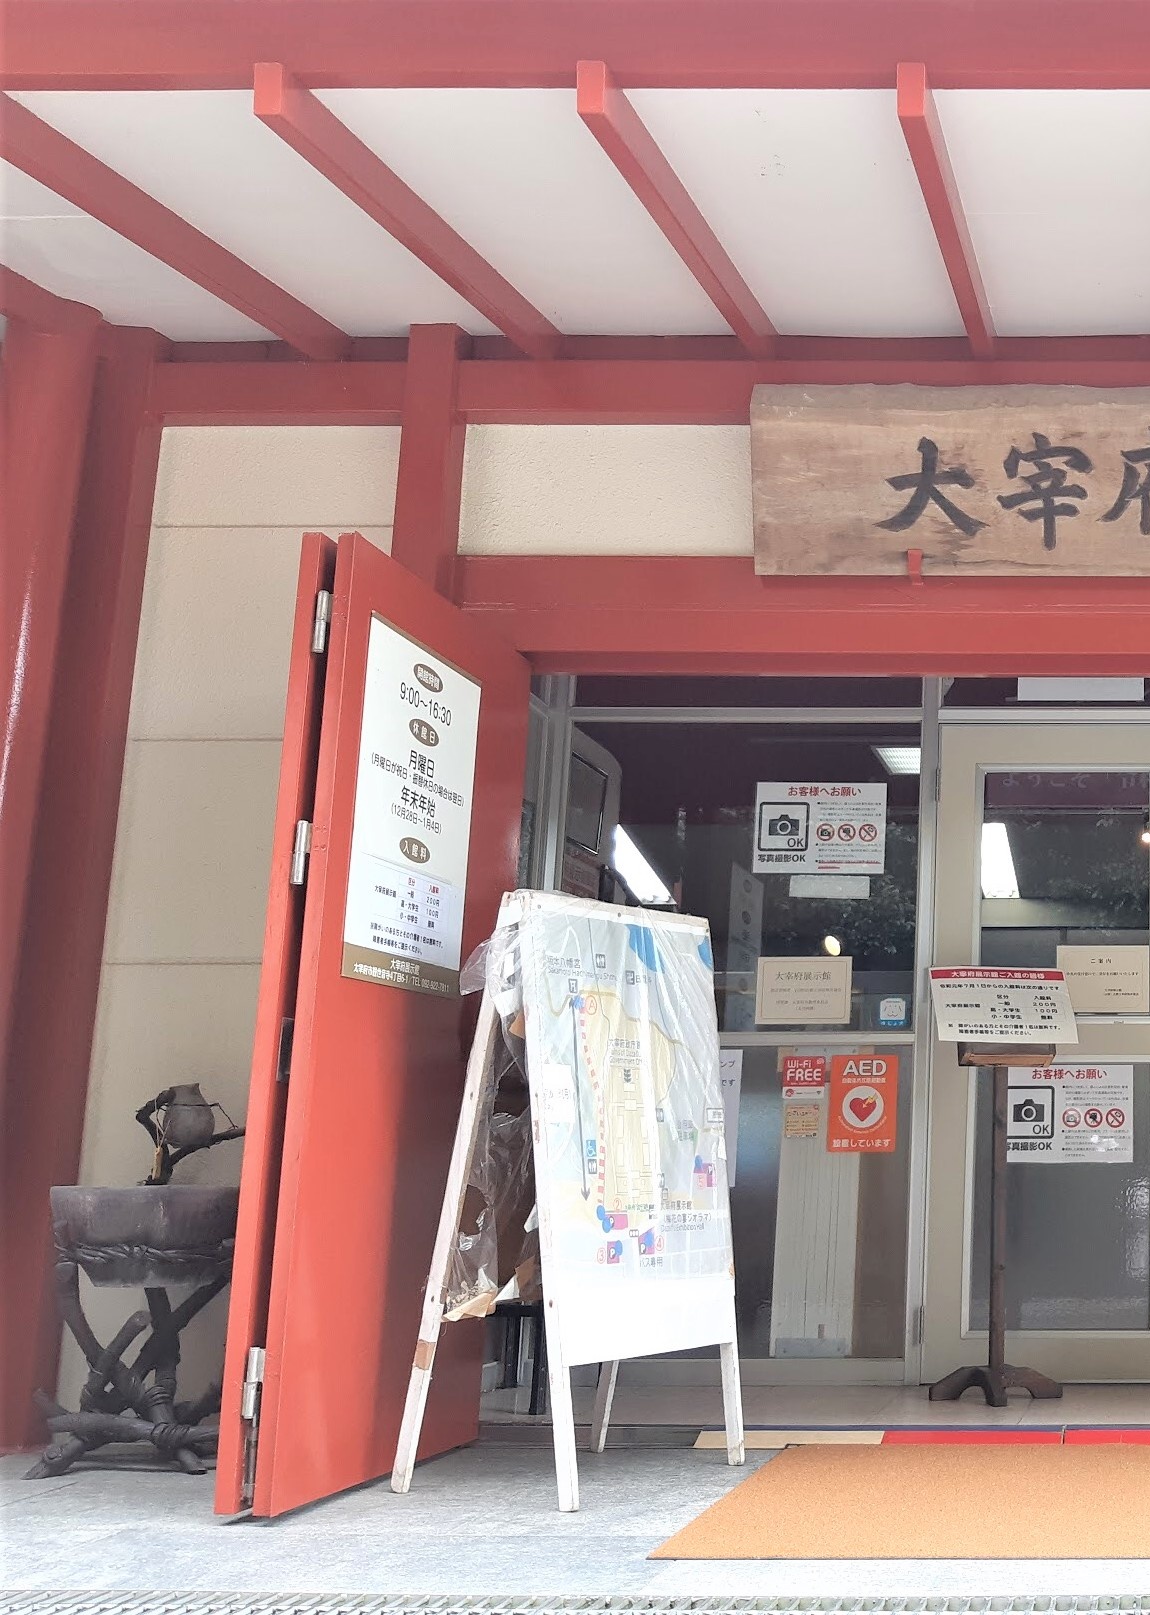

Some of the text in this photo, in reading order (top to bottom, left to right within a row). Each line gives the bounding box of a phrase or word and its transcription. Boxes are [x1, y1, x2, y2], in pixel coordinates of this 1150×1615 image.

[417, 665, 440, 691] 開館時間
[412, 719, 436, 745] 休館日
[409, 749, 435, 779] 月曜日
[787, 786, 861, 797] お客様へお願い
[400, 785, 436, 818] 年末年始
[787, 837, 805, 848] OK
[402, 839, 428, 861] 入館料
[757, 853, 806, 863] 写真撮影OK
[787, 1060, 812, 1069] Wi-Fi
[842, 1059, 888, 1077] AED
[786, 1068, 822, 1082] FREE
[1031, 1068, 1108, 1080] お客様へお願い
[1032, 1124, 1050, 1135] OK
[832, 1138, 892, 1148] 設置しています
